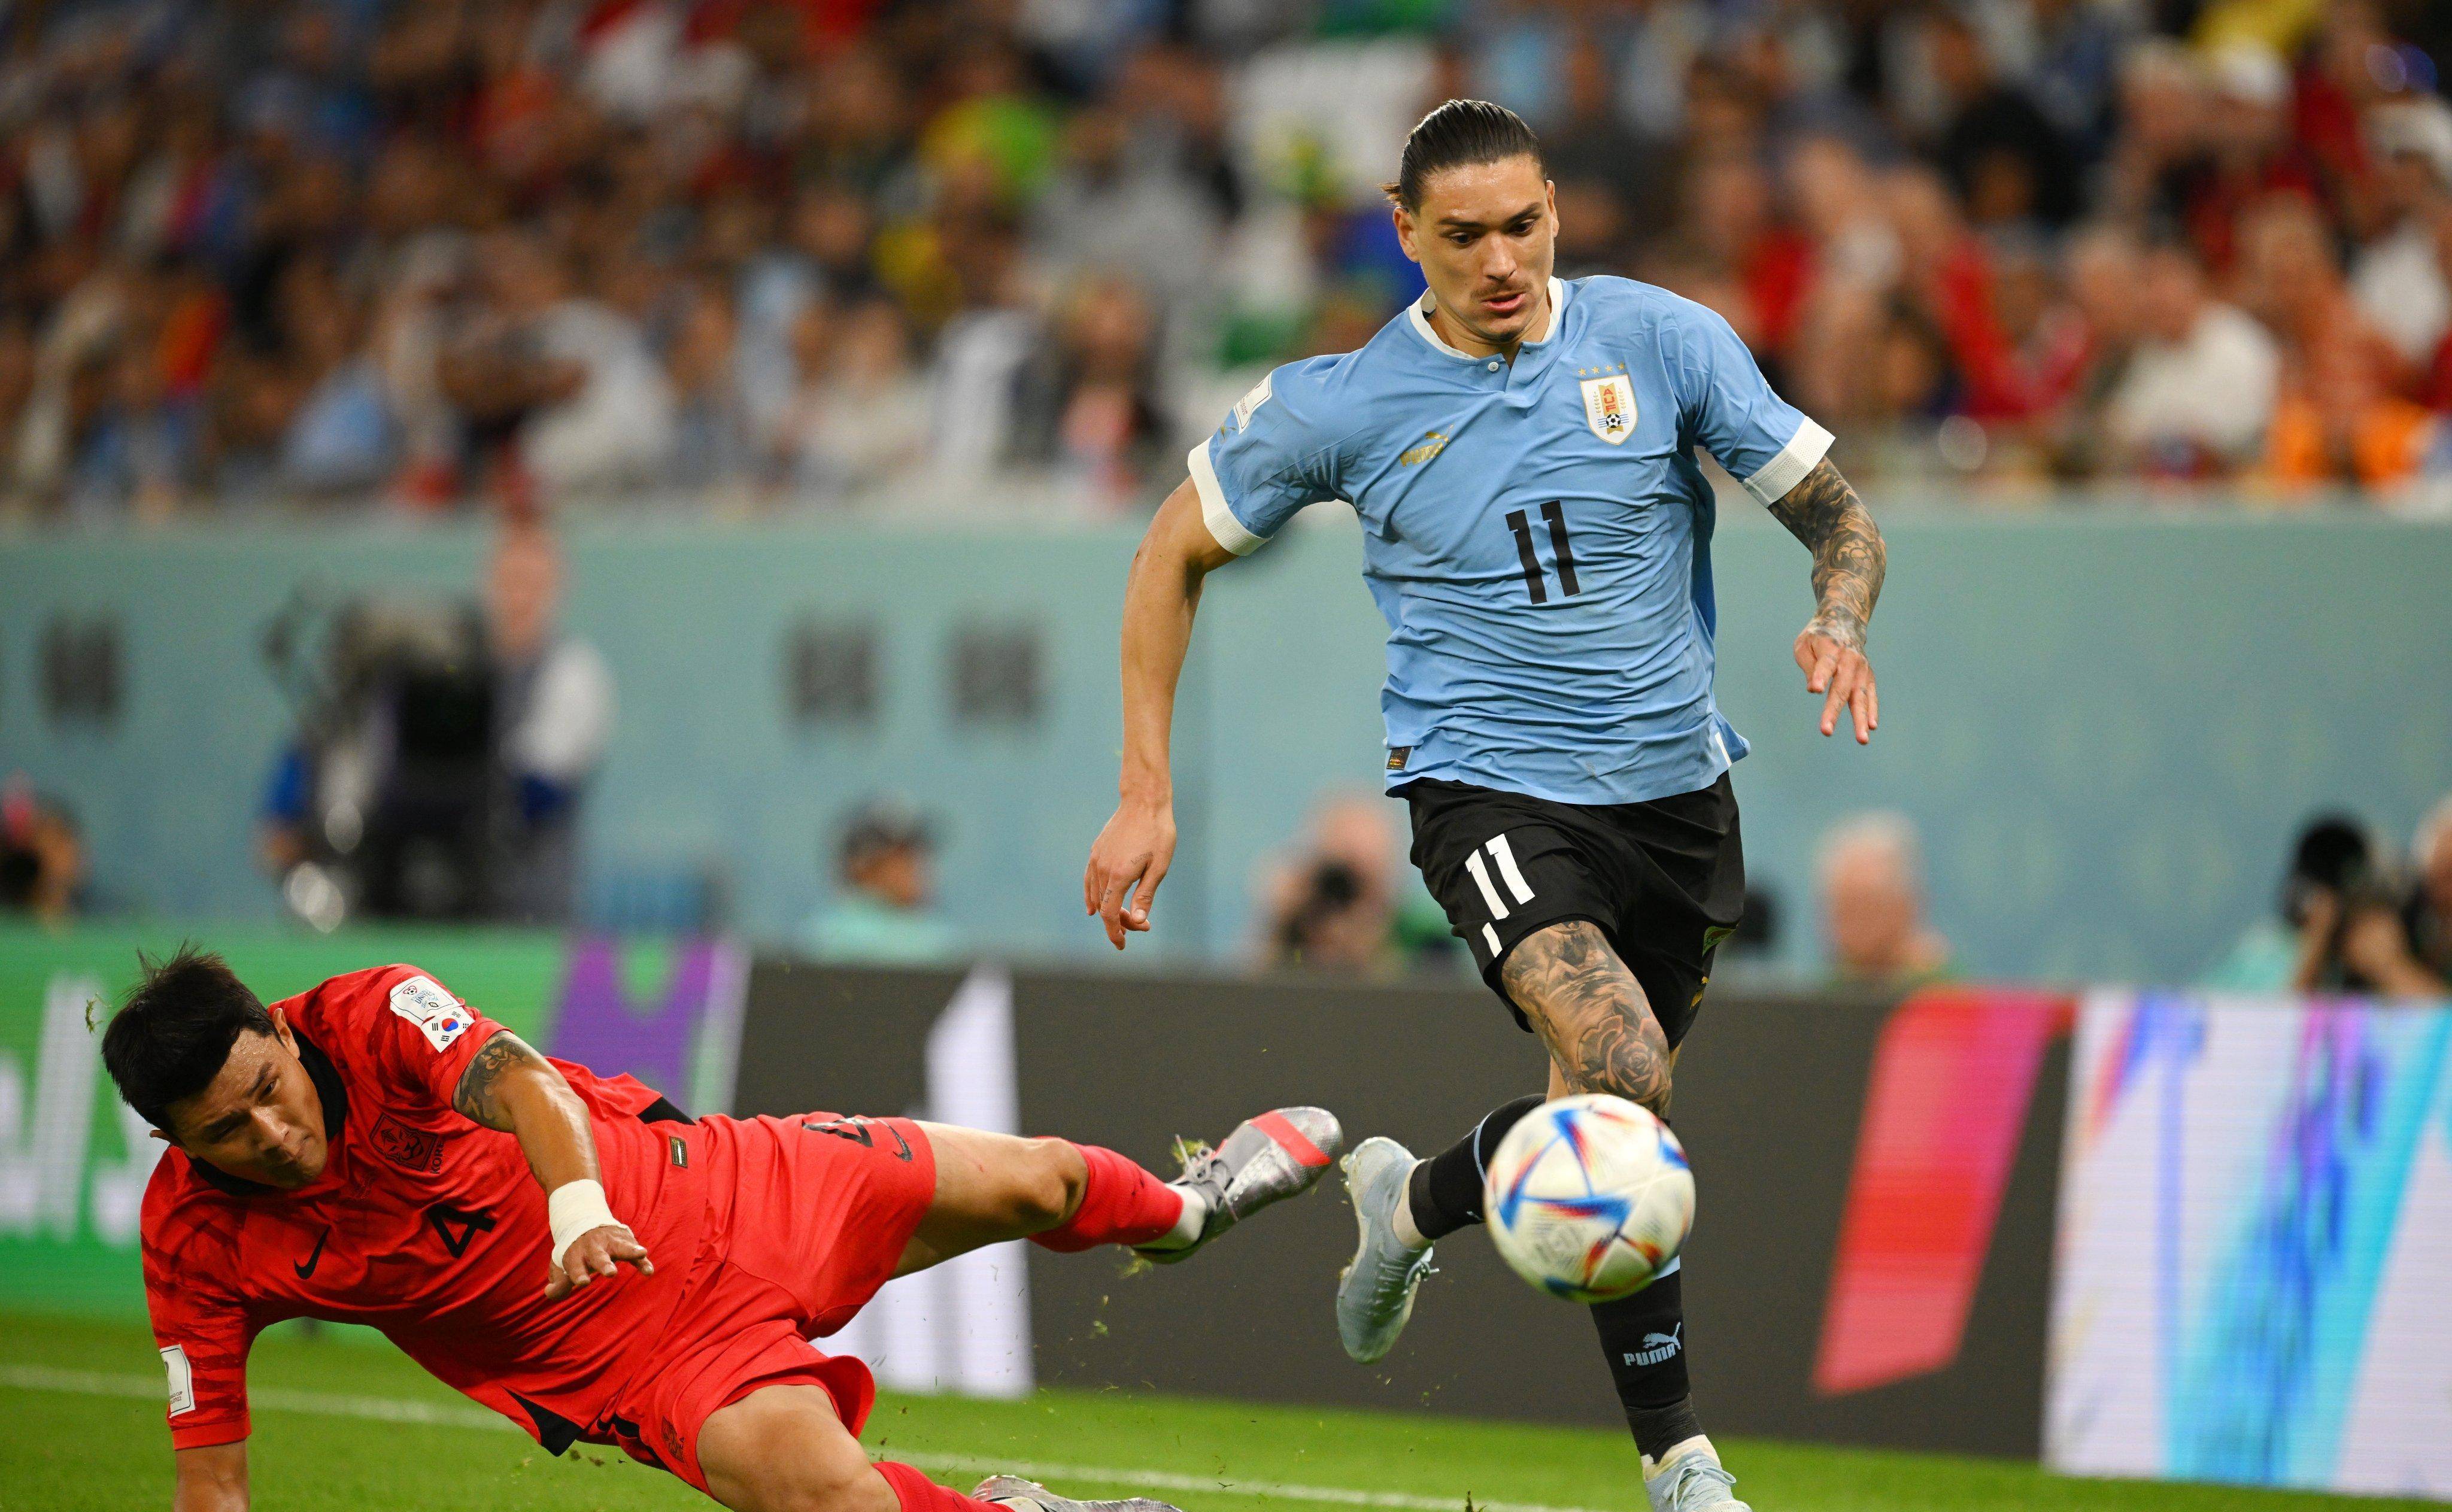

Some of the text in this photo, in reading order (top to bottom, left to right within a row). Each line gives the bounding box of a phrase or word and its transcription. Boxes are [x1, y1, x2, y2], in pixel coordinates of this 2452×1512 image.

[1506, 500, 1580, 605] 11
[1465, 833, 1535, 920] 11
[426, 1203, 497, 1259] 4
[1623, 1343, 1676, 1366] PUMA
